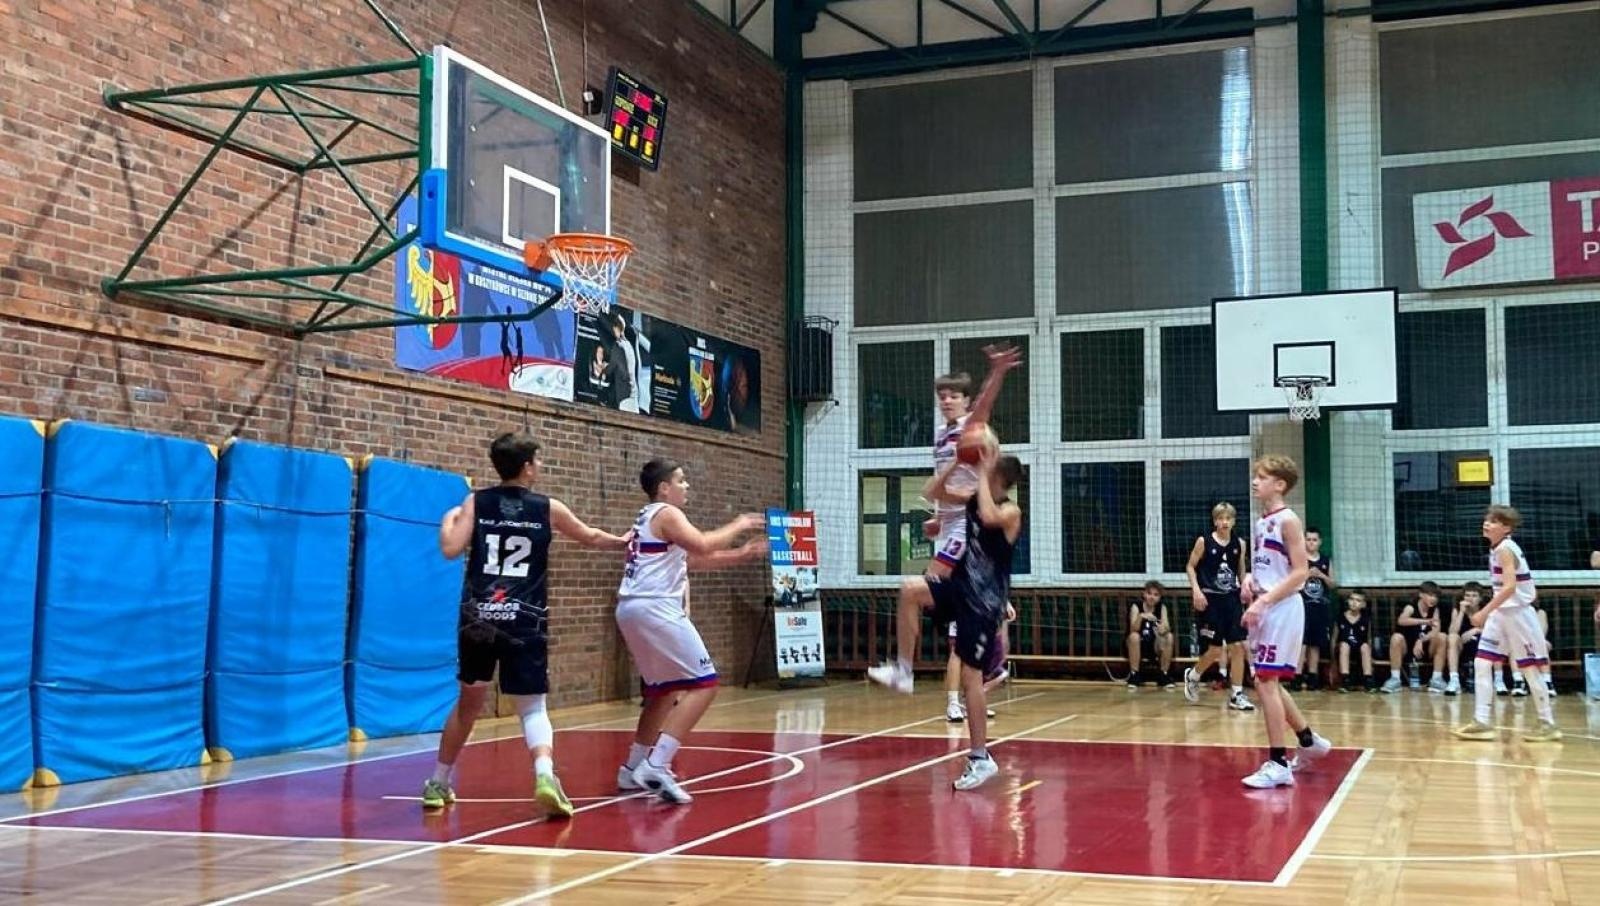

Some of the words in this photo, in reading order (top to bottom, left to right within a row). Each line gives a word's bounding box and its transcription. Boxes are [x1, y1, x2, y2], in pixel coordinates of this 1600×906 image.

[1567, 190, 1600, 233] T
[483, 534, 532, 577] 12
[772, 550, 814, 562] BASKETBALL
[477, 602, 520, 612] CEDROB
[479, 611, 517, 620] FOODS
[1257, 644, 1277, 663] 35
